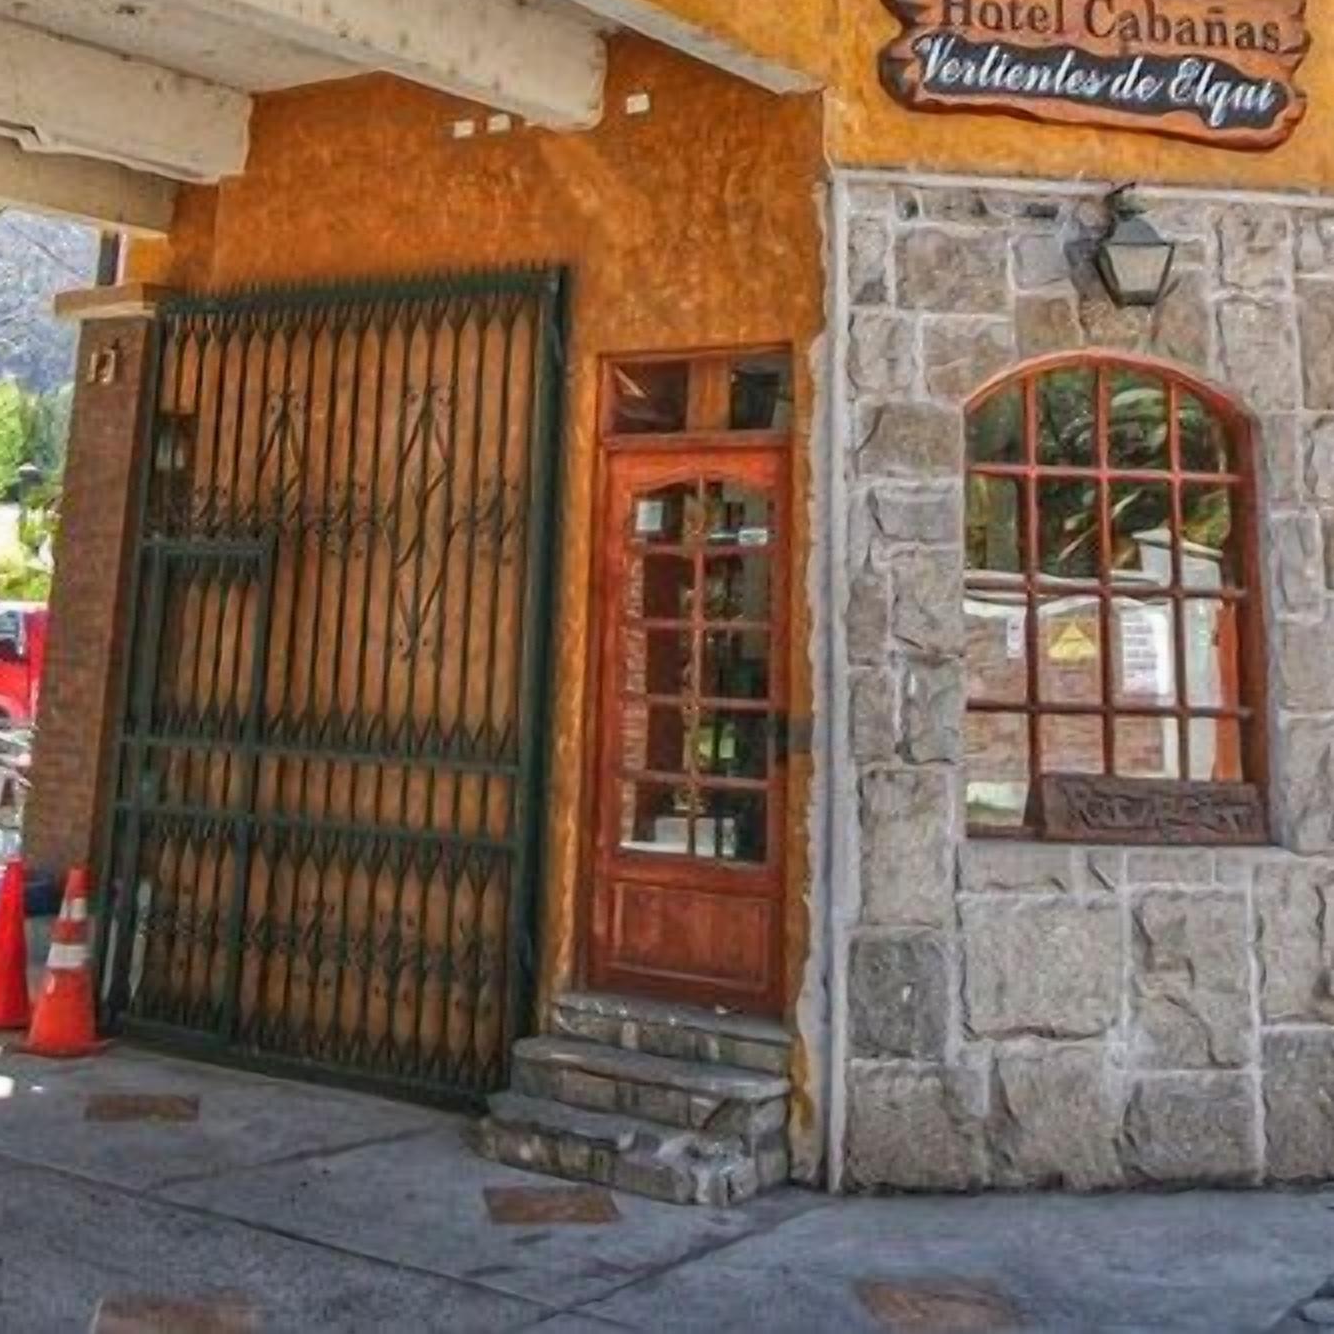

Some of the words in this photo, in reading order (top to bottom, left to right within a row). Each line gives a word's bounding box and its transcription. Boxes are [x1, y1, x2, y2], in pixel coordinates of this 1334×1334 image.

[913, 32, 1108, 97] Vertientes
[1108, 56, 1164, 102] de
[1168, 57, 1277, 129] Elqui
